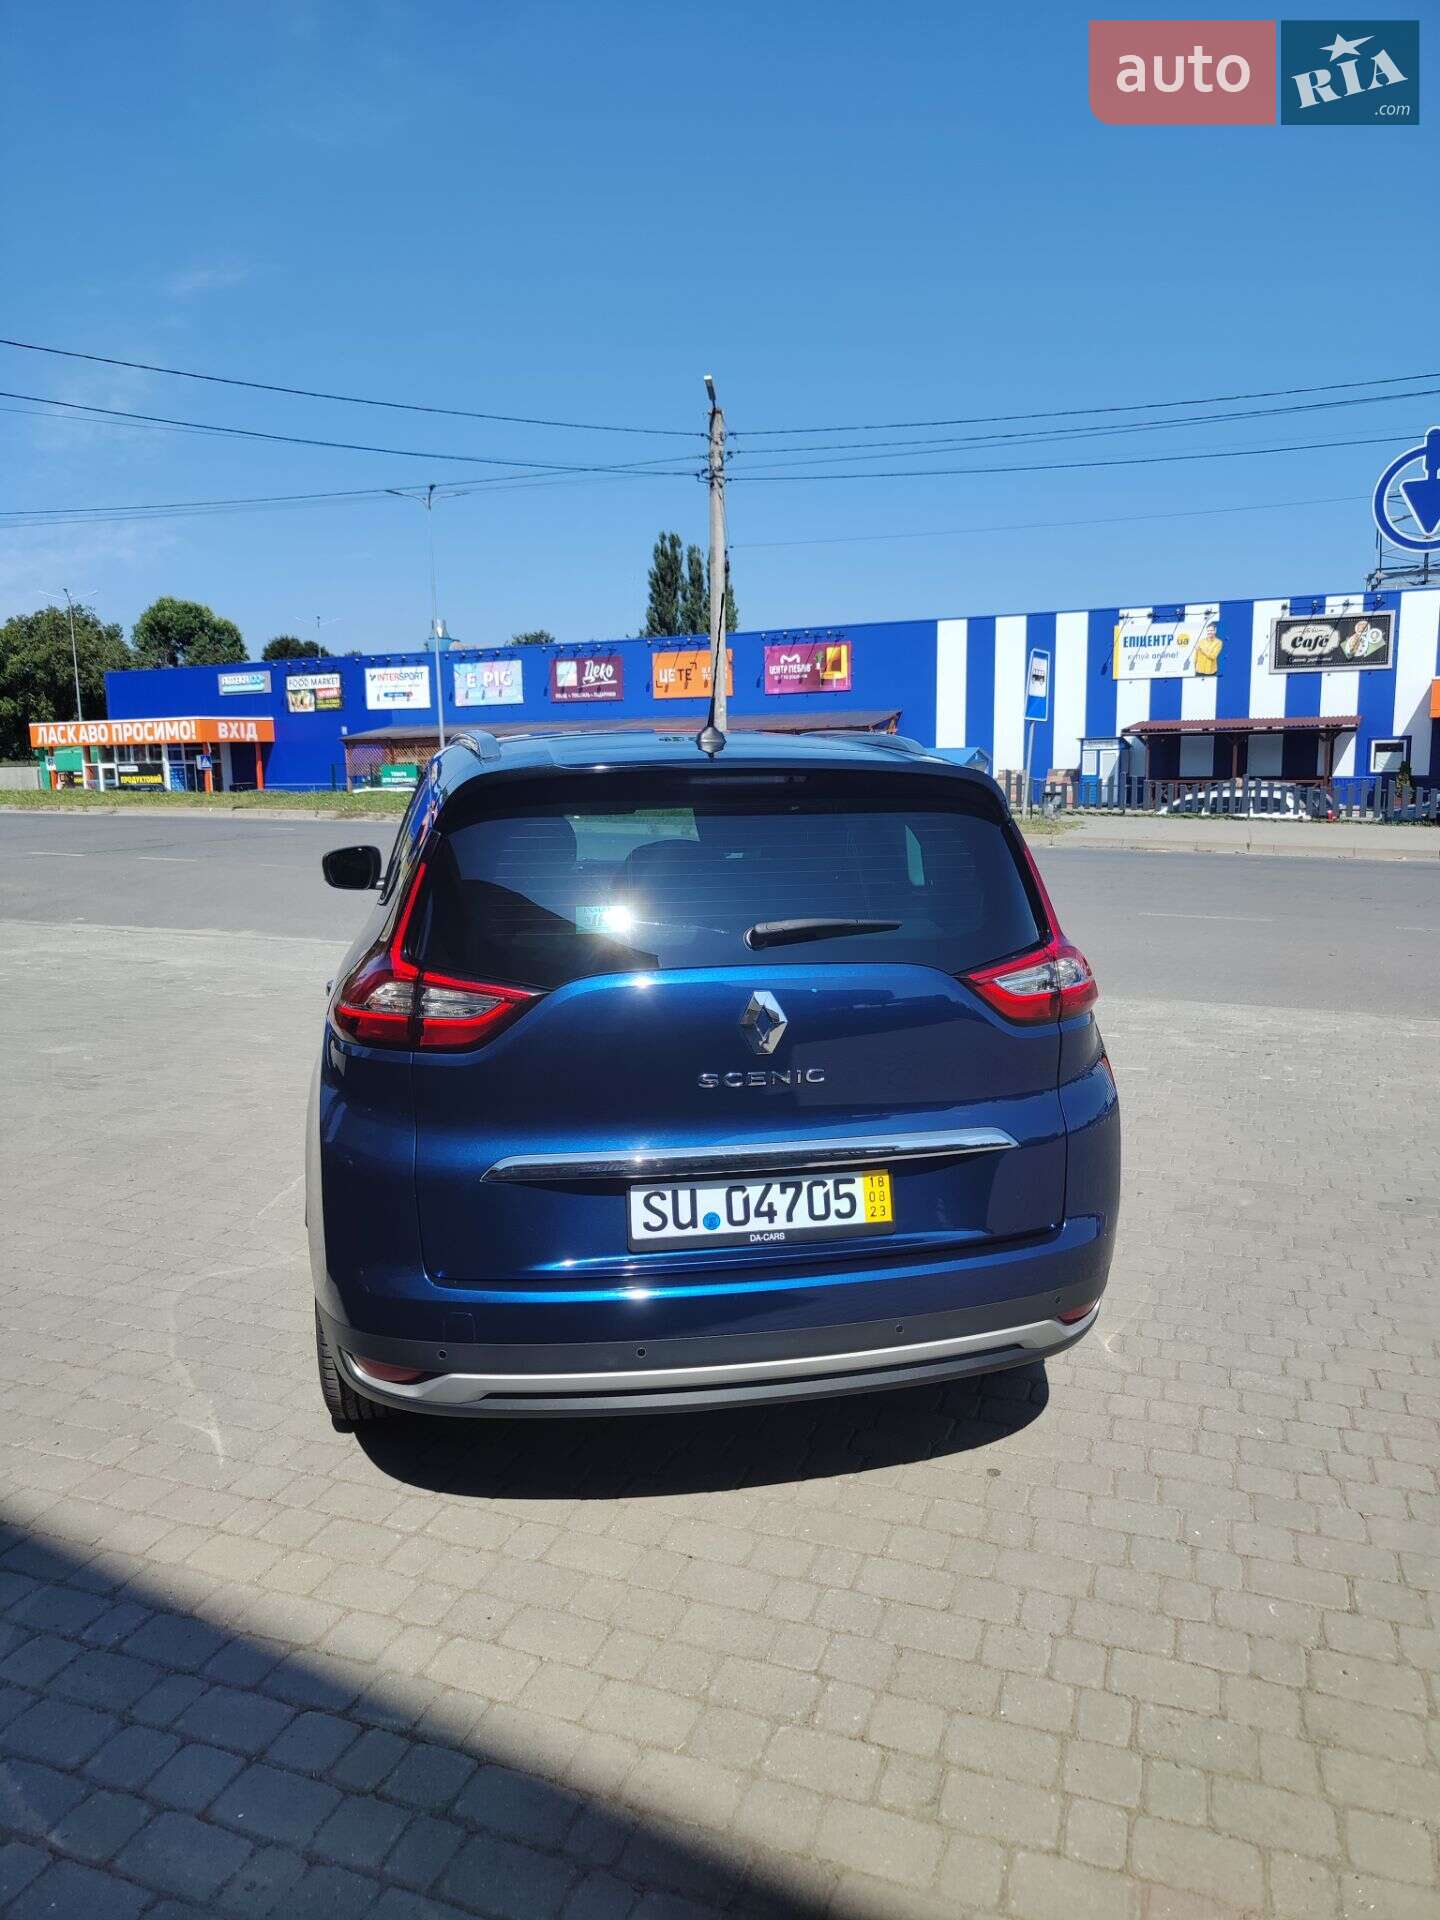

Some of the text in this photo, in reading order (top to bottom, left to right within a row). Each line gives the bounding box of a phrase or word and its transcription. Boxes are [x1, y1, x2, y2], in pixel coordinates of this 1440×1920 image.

[1123, 634, 1173, 648] ЕПІЦЕНТР
[1290, 633, 1330, 652] Café
[288, 677, 339, 687] FOOD MARKET
[377, 671, 424, 682] INTERSPORT
[37, 720, 196, 745] ЛАСКАВО ПРОСИМО!
[217, 721, 258, 741] ВХІД
[697, 1068, 825, 1088] SCENIC
[869, 1176, 885, 1188] 18
[642, 1178, 857, 1232] SU 04705
[870, 1205, 887, 1217] 23
[749, 1231, 786, 1242] DA-CARS
